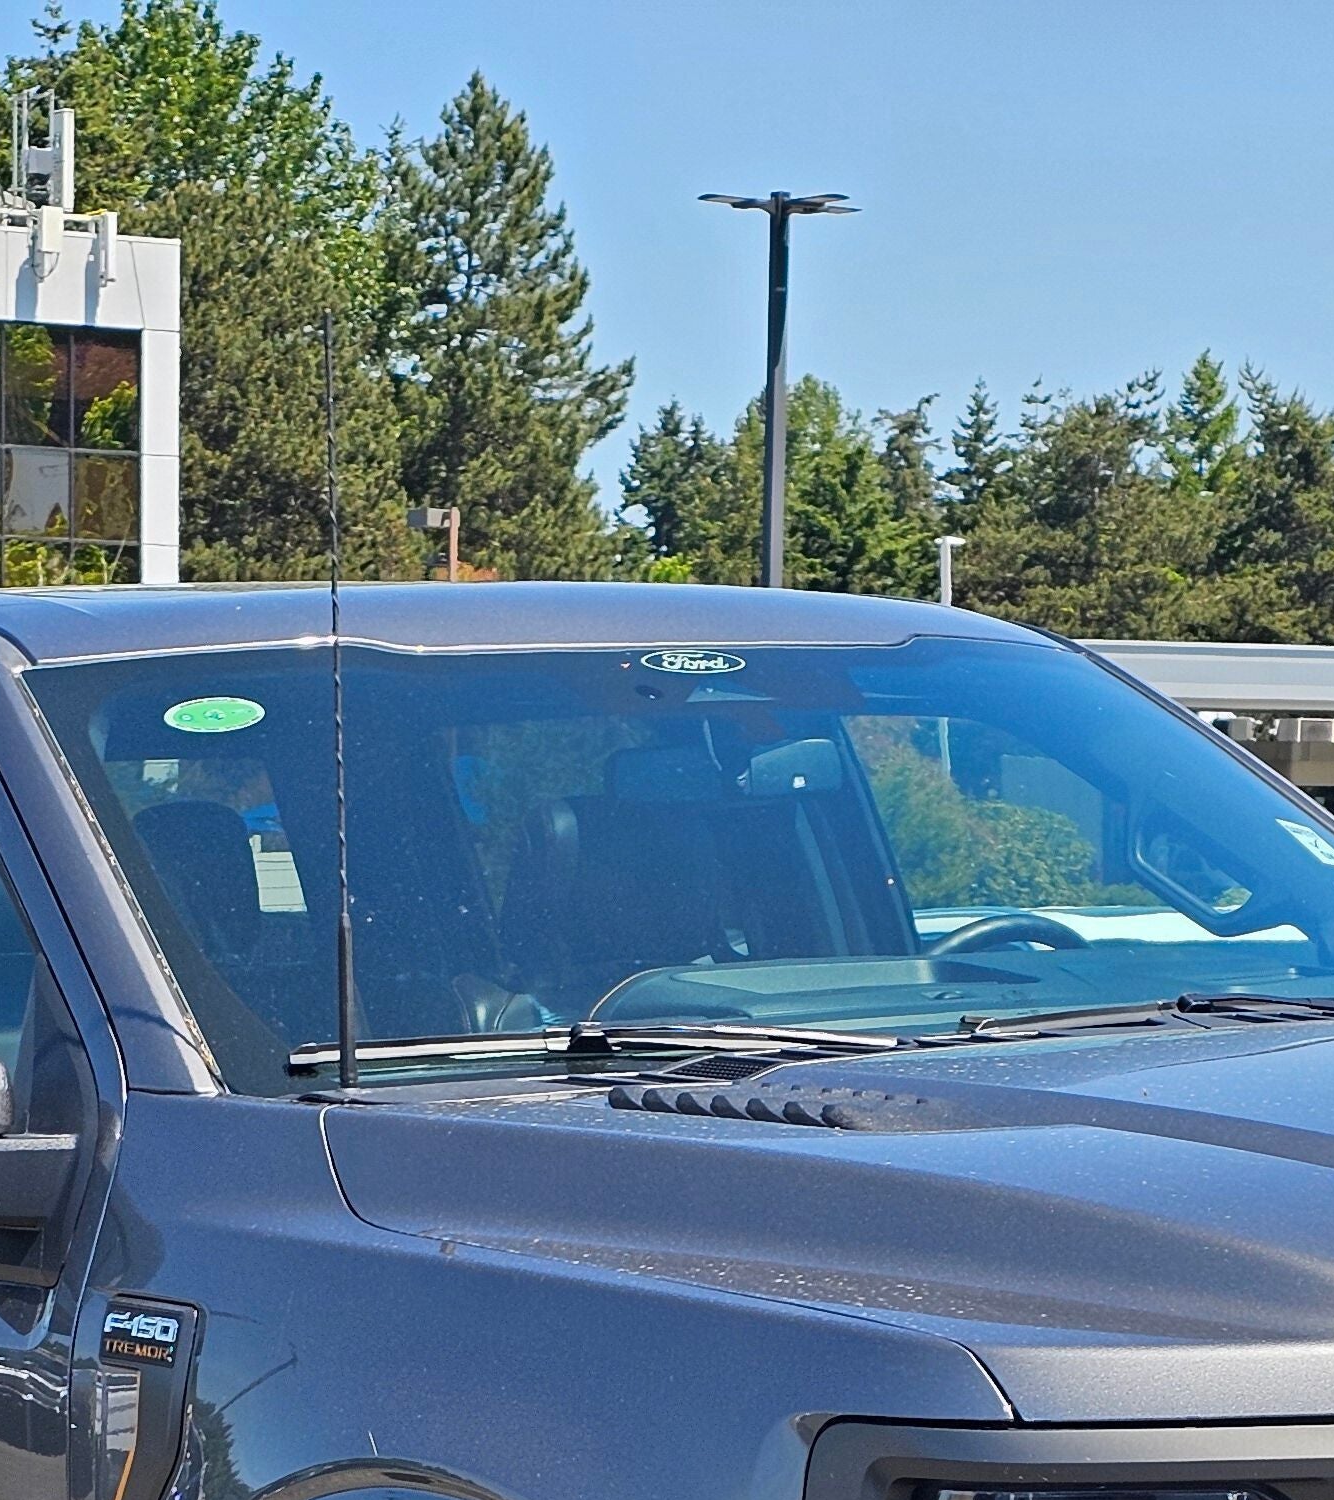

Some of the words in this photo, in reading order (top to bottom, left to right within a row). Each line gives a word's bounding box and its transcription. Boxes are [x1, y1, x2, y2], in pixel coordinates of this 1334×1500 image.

[662, 653, 729, 670] Ford
[104, 1311, 178, 1342] F-150
[105, 1339, 169, 1359] TREMOR
